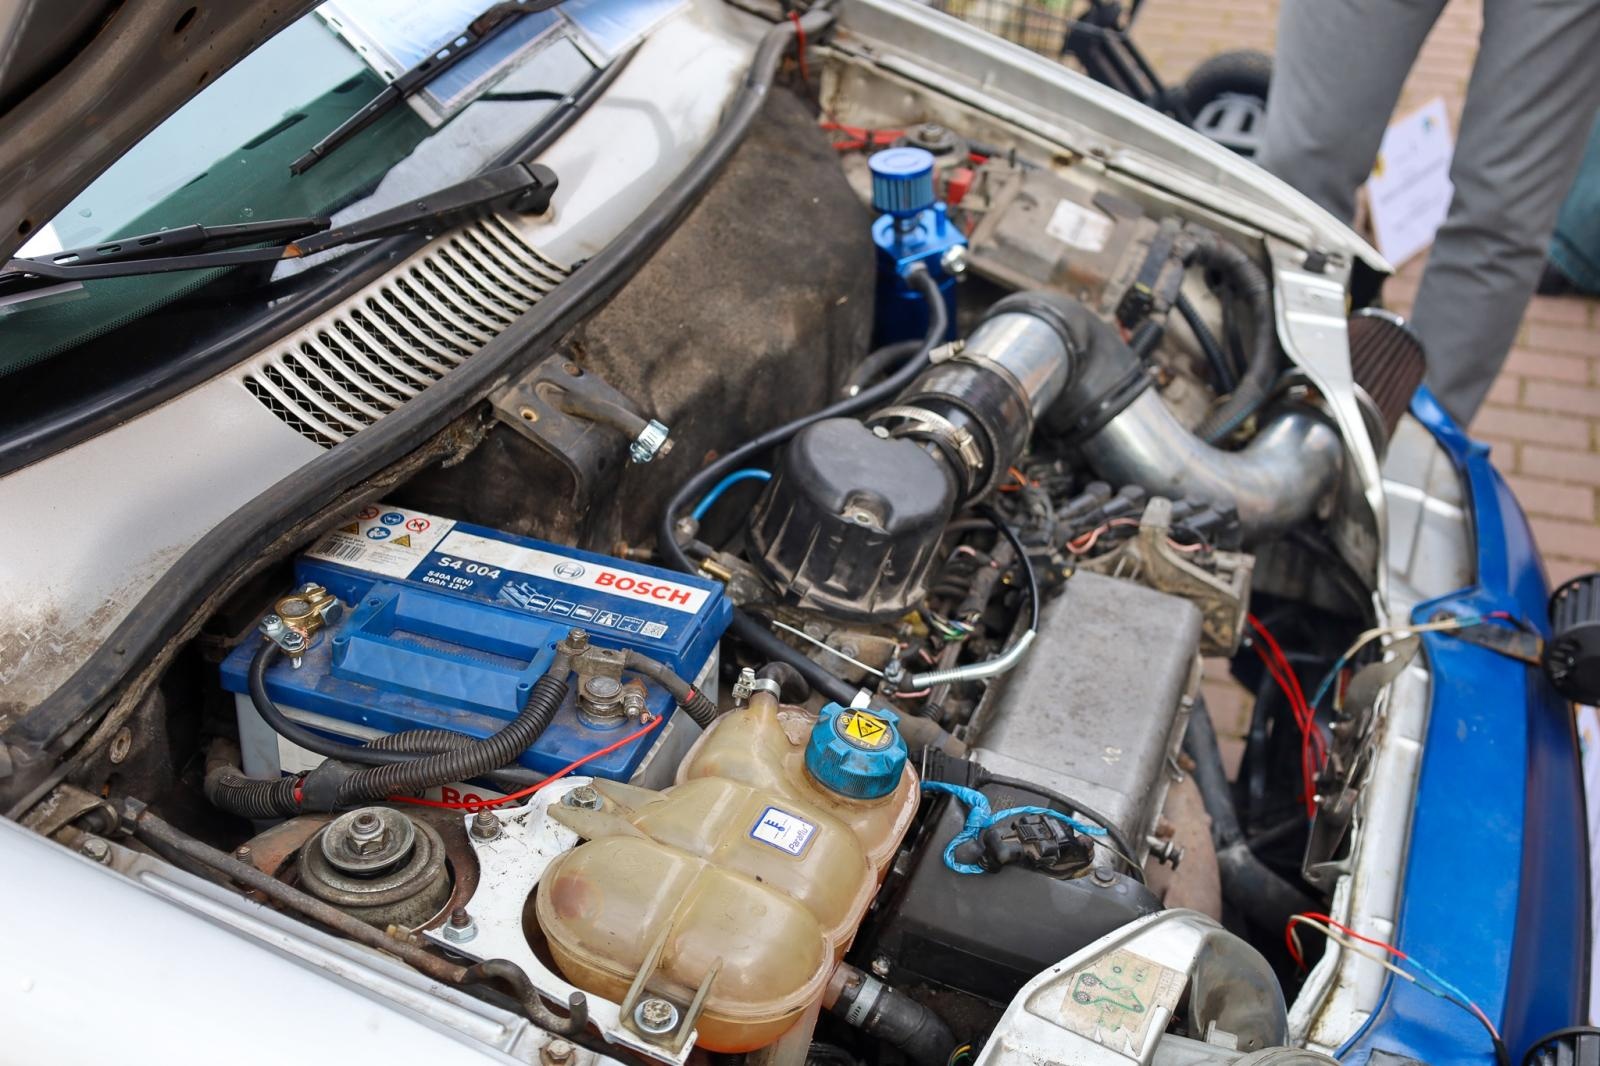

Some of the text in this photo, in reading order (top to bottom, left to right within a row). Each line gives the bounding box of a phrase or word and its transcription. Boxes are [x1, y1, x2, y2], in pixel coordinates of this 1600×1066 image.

[438, 557, 501, 580] S4 004
[422, 576, 468, 591] 60Ah 12V
[427, 570, 474, 588] 540A (EN)
[595, 572, 692, 605] BOSCH
